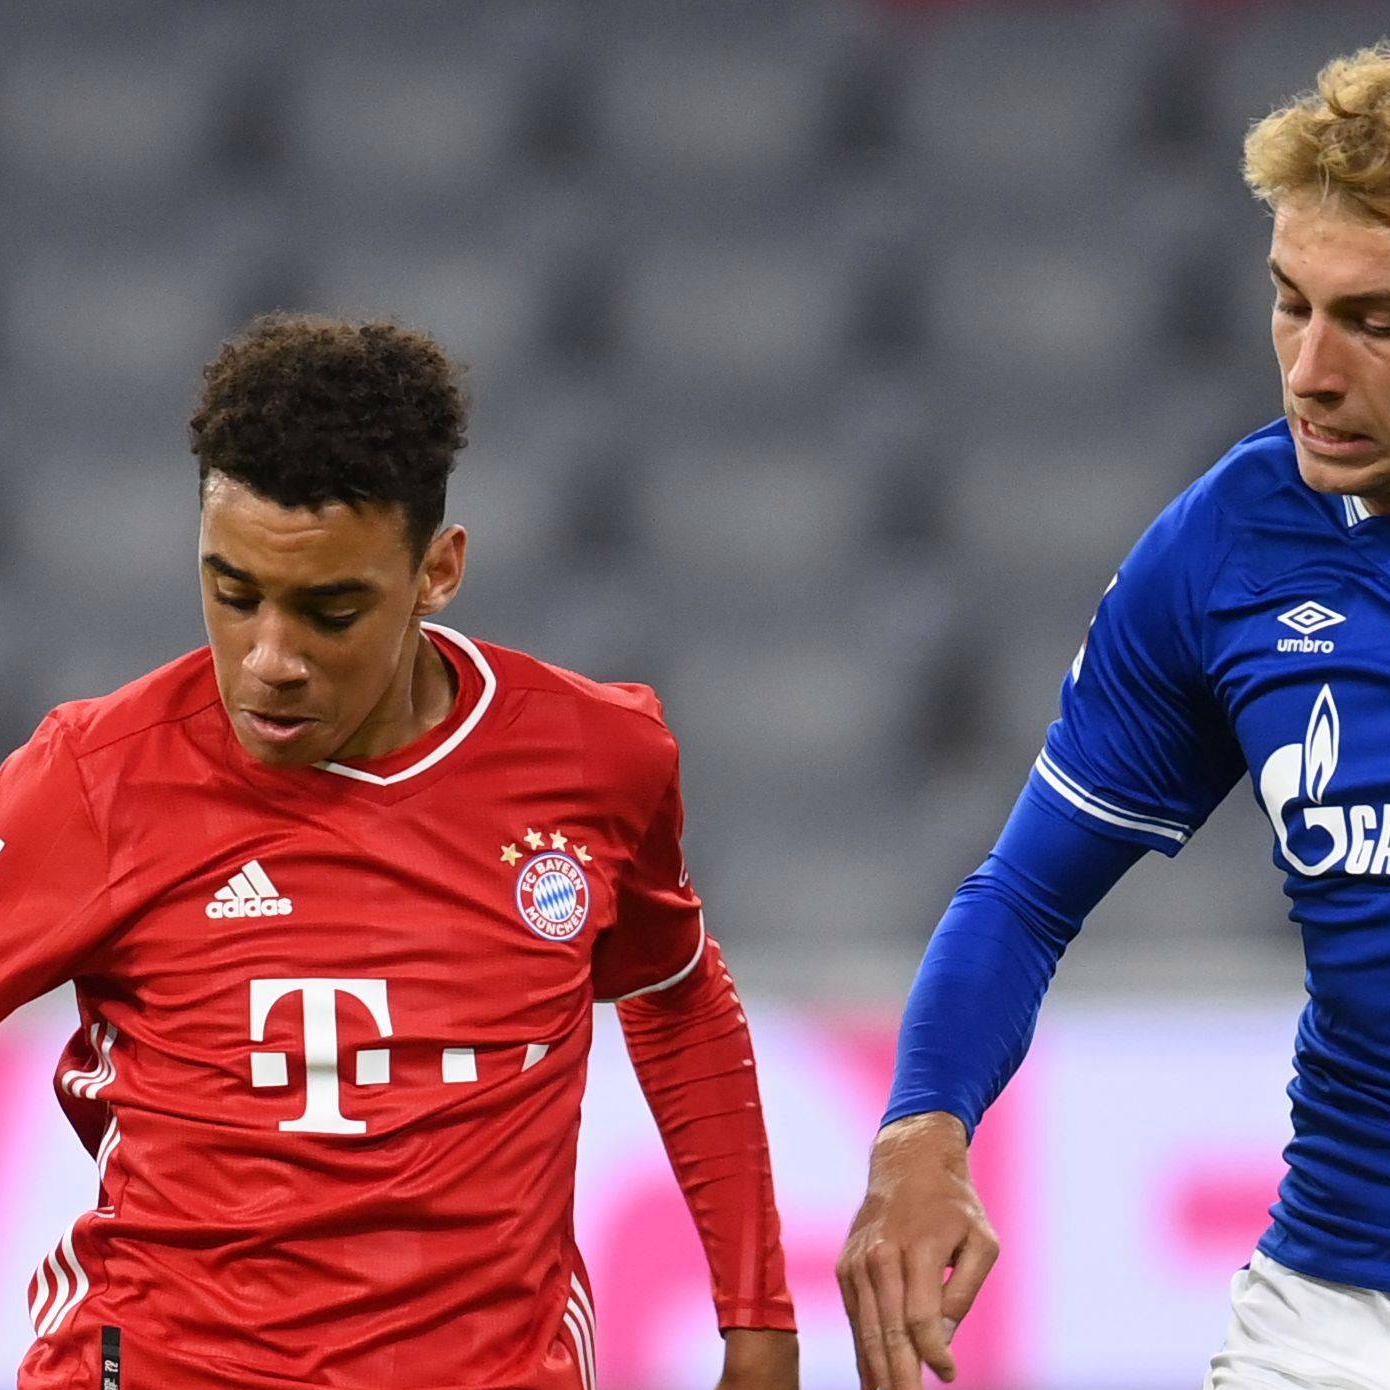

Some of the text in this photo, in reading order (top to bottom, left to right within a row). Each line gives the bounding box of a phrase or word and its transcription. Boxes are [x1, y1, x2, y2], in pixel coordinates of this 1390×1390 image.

[1277, 636, 1334, 653] umbro
[535, 859, 584, 890] BAYERN
[205, 897, 292, 919] adidas
